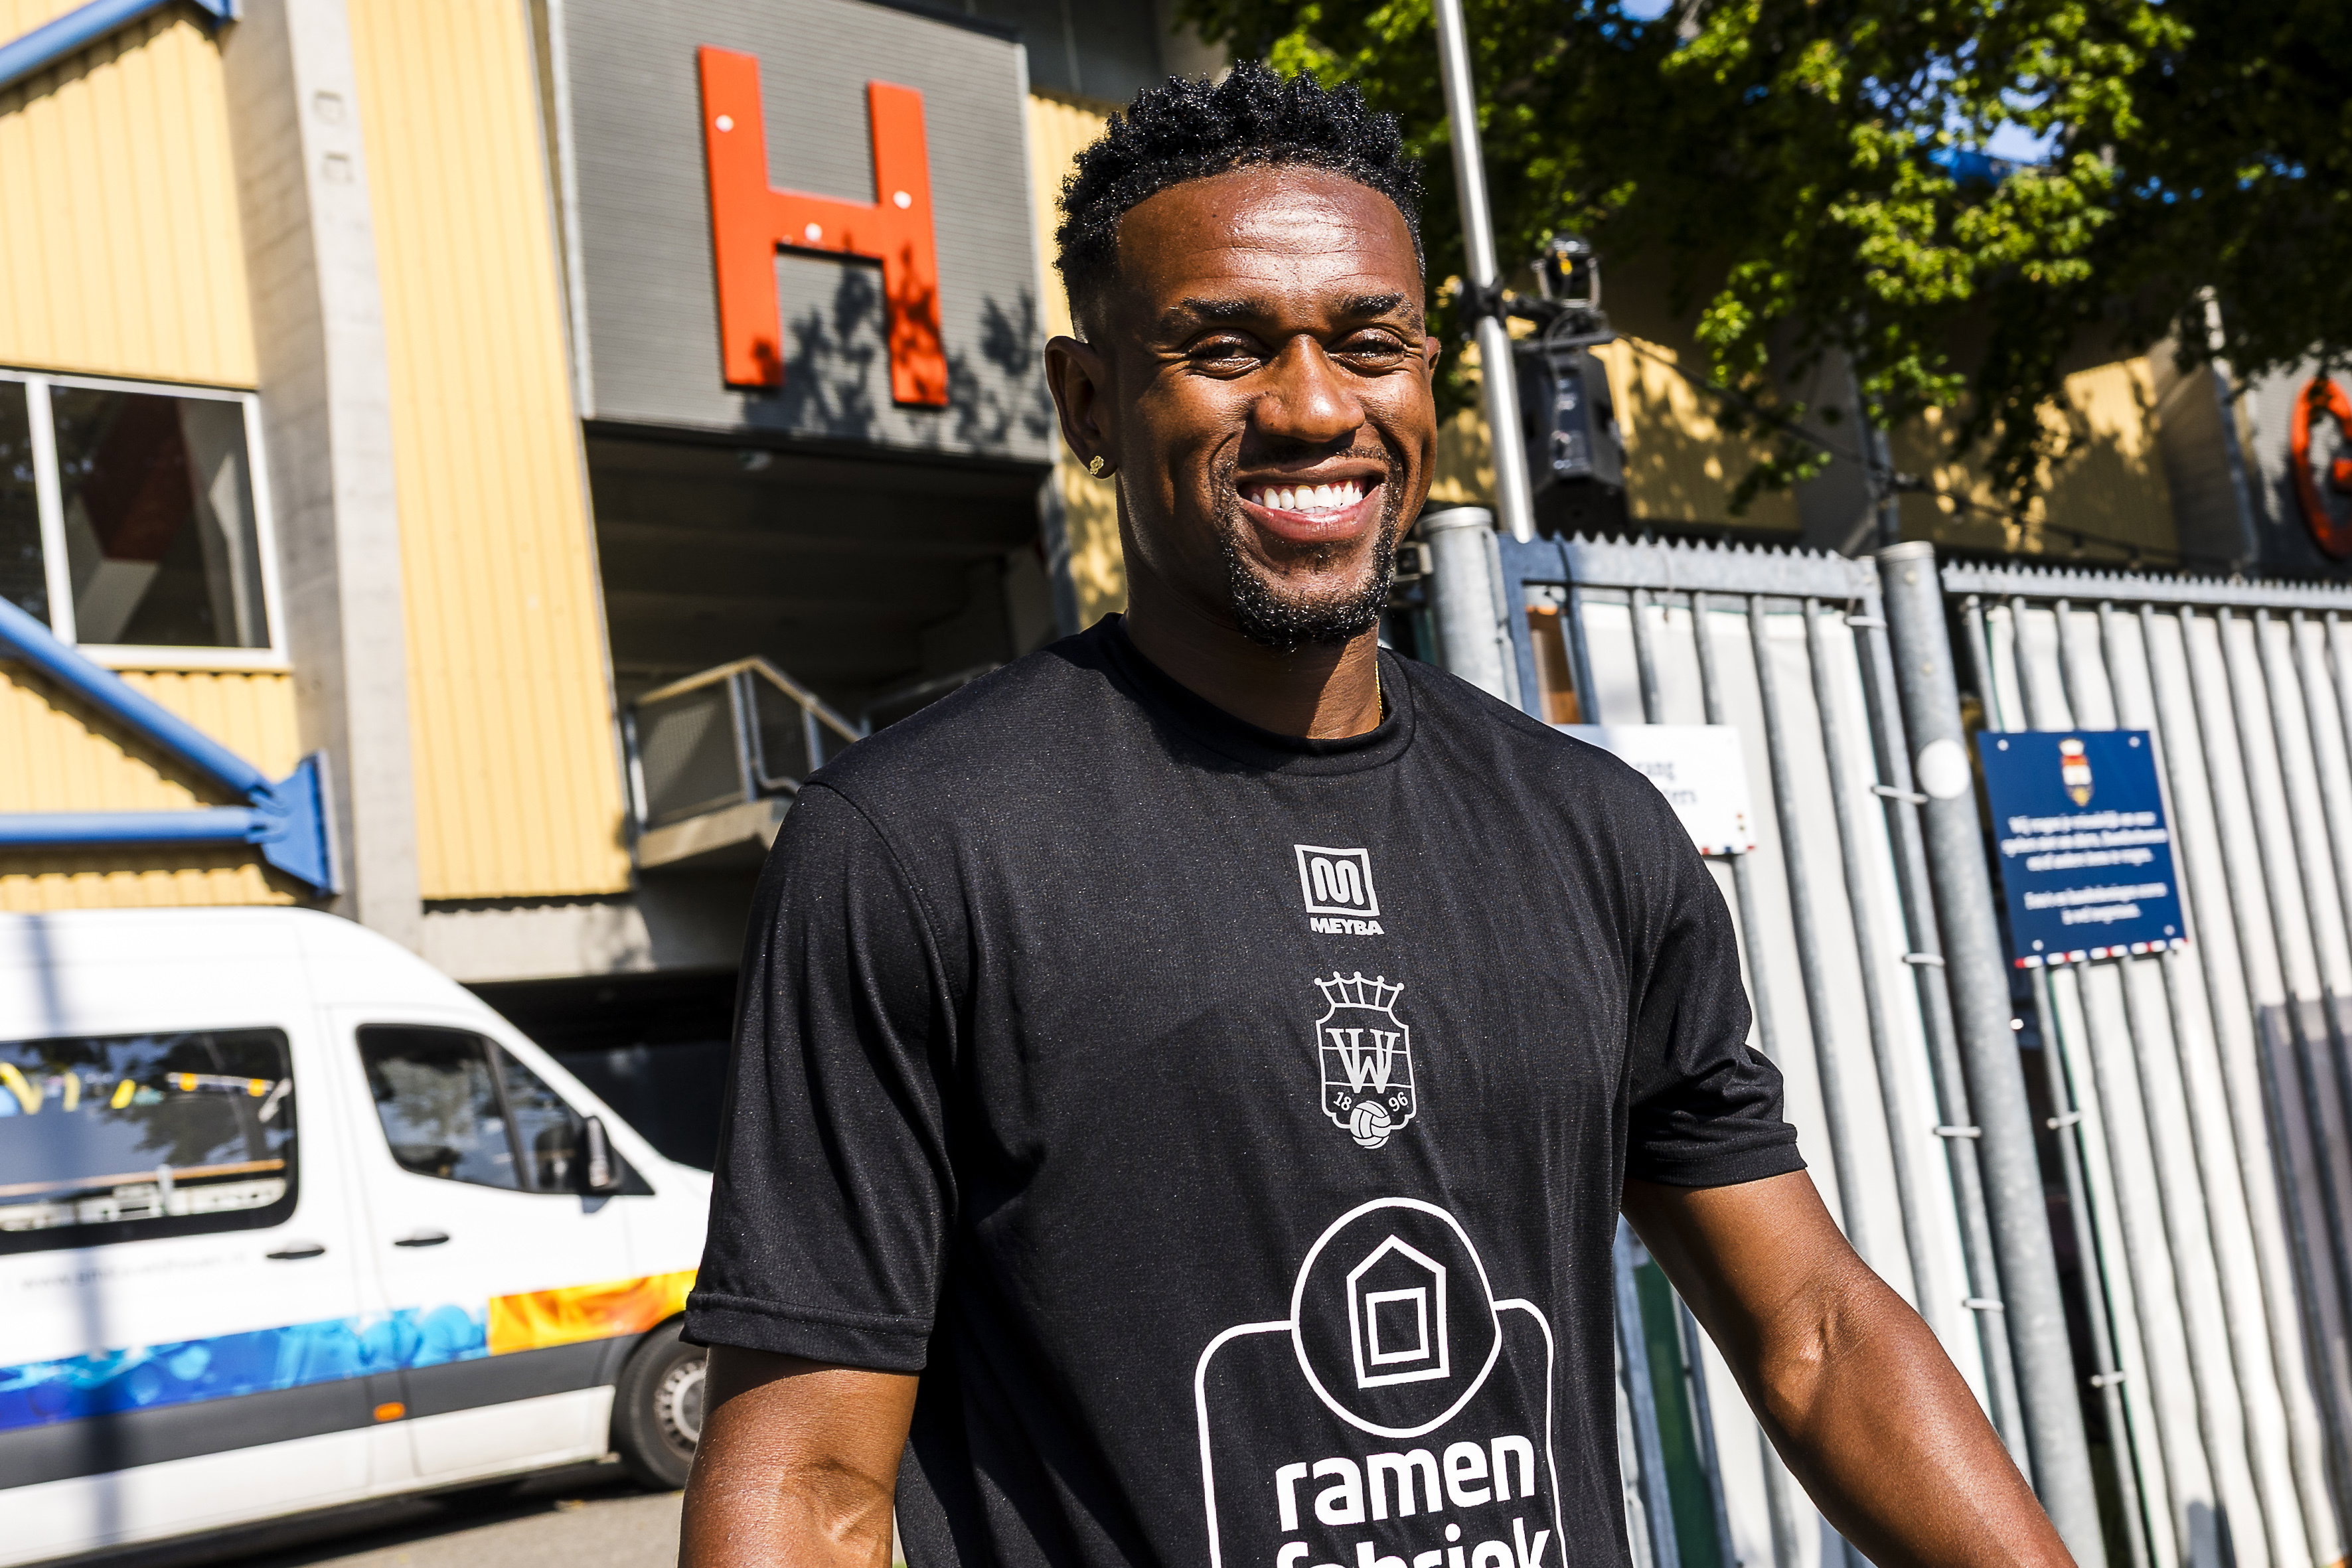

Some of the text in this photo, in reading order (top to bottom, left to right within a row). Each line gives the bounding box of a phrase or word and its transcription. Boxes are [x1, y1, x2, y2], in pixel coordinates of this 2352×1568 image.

[697, 44, 948, 406] H
[1310, 917, 1385, 936] MEYBA
[1275, 1435, 1535, 1532] ramen
